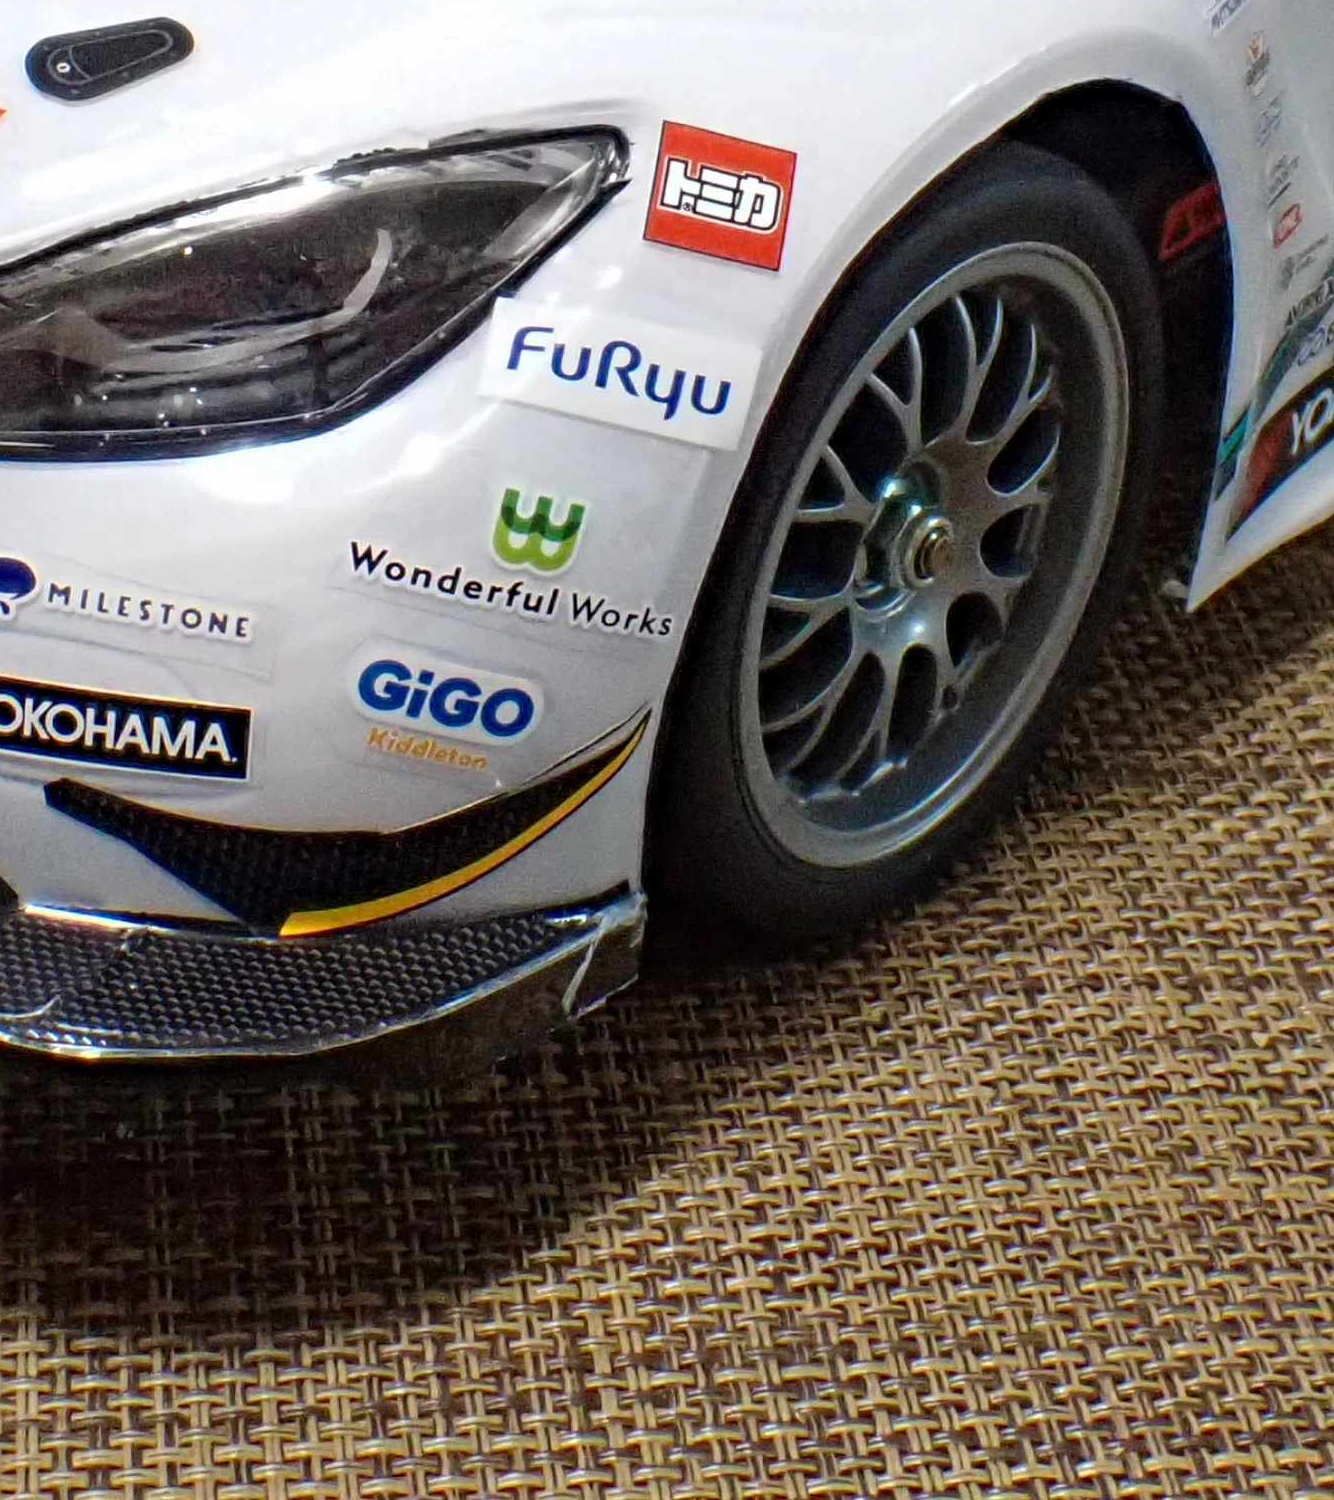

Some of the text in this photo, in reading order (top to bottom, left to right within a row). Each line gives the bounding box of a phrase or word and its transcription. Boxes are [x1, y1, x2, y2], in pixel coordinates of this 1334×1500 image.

[657, 156, 784, 234] トミカ
[505, 324, 732, 422] FuRyu
[47, 580, 250, 641] MILESTONE
[348, 539, 674, 640] Wonderful Works
[357, 657, 537, 740] GiGO
[367, 724, 489, 774] Kiddleton
